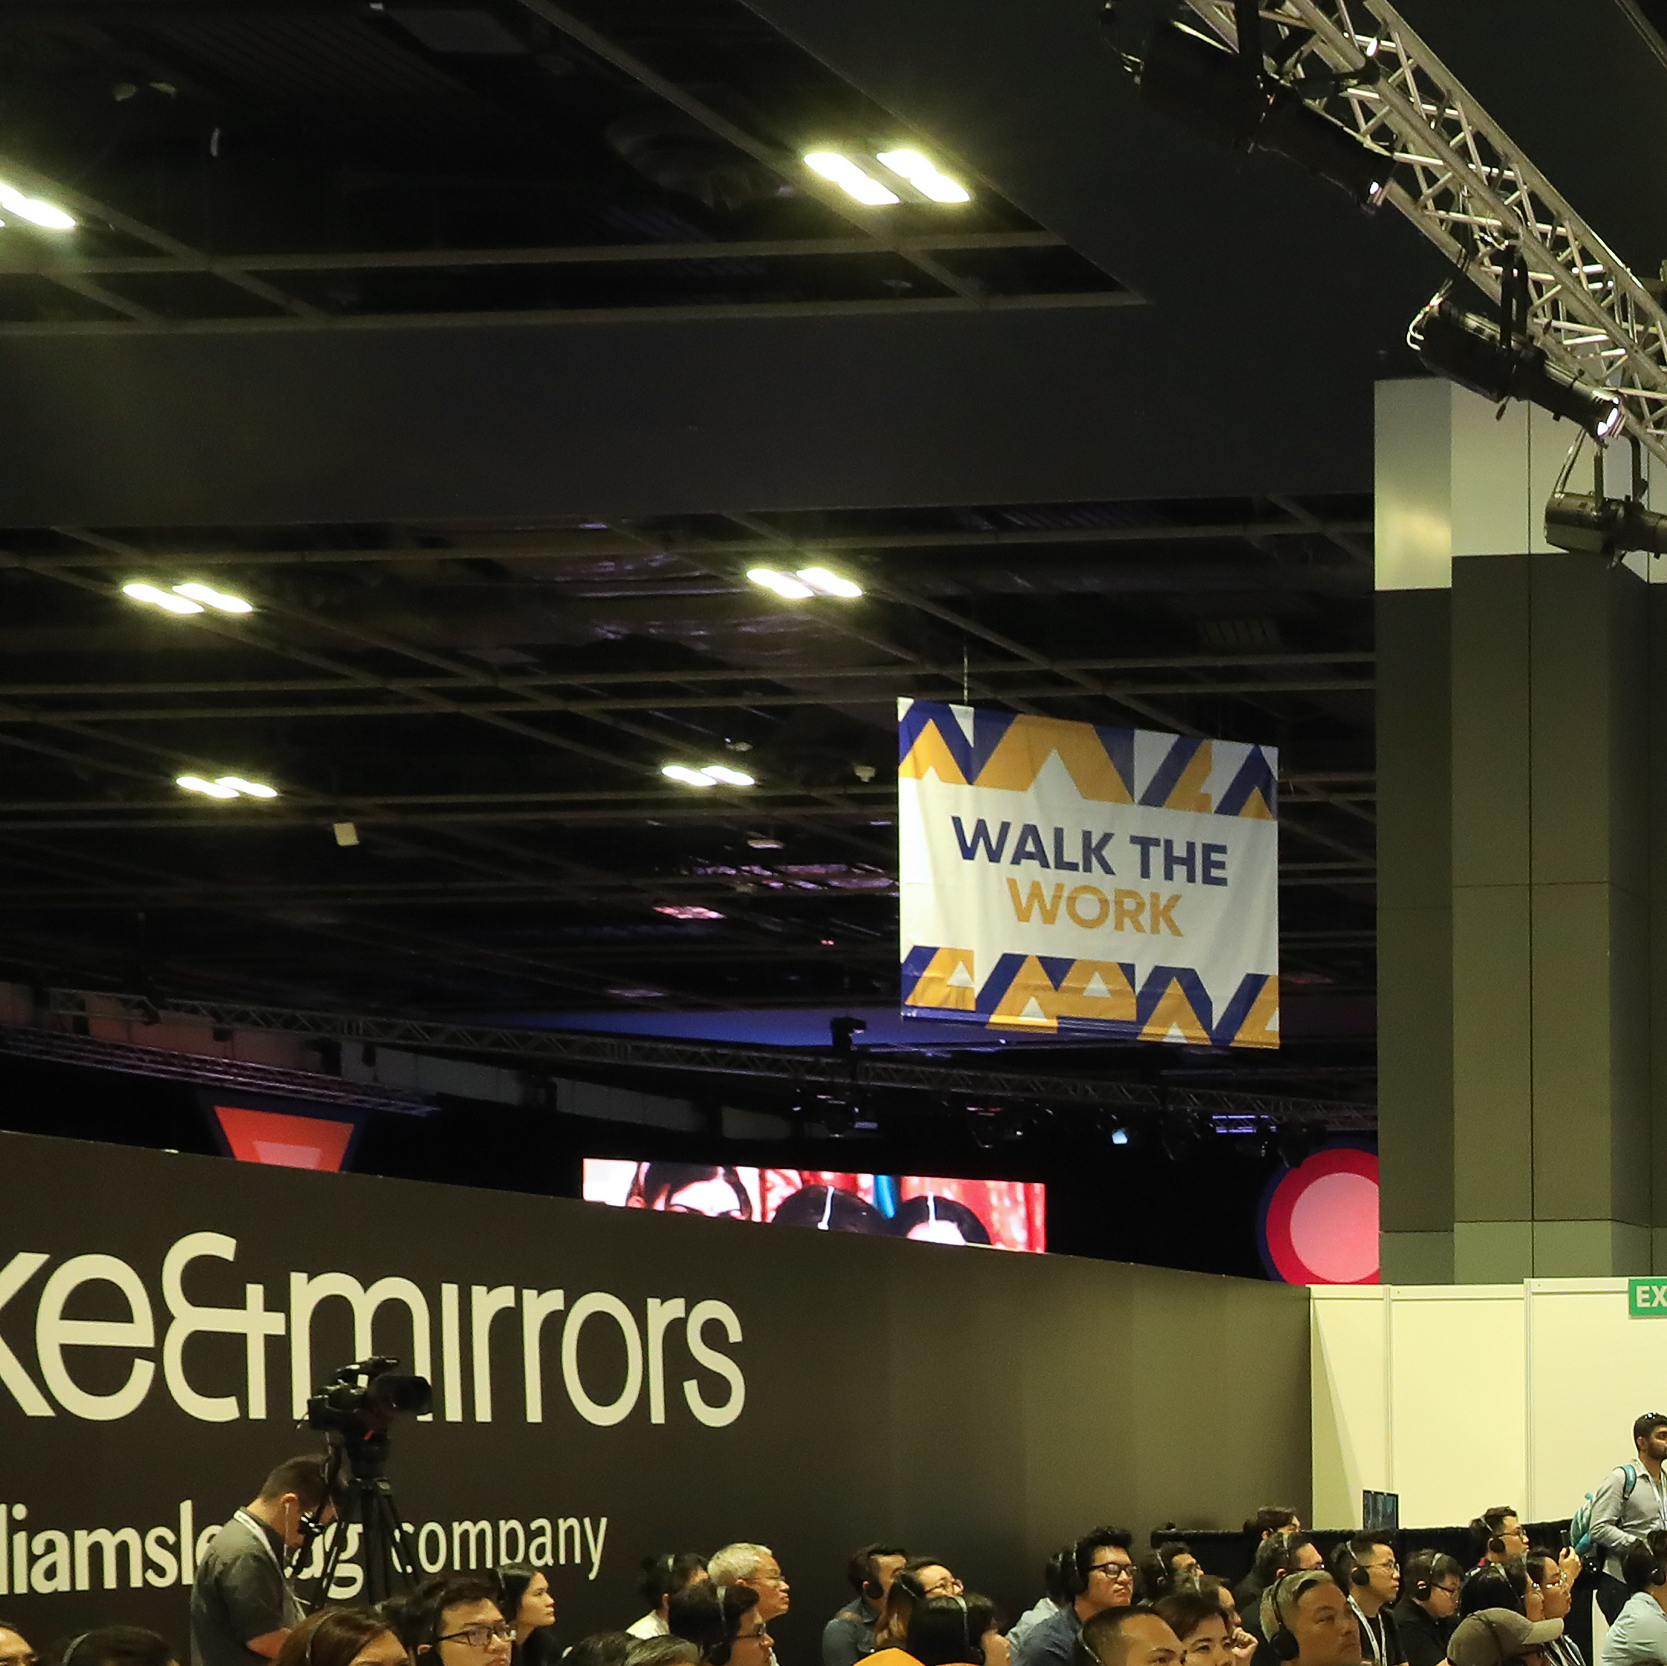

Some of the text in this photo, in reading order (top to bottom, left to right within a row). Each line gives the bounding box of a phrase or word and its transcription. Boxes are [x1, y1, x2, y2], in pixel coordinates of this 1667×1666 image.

[950, 815, 1229, 887] WALK THE
[1004, 876, 1185, 938] WORK
